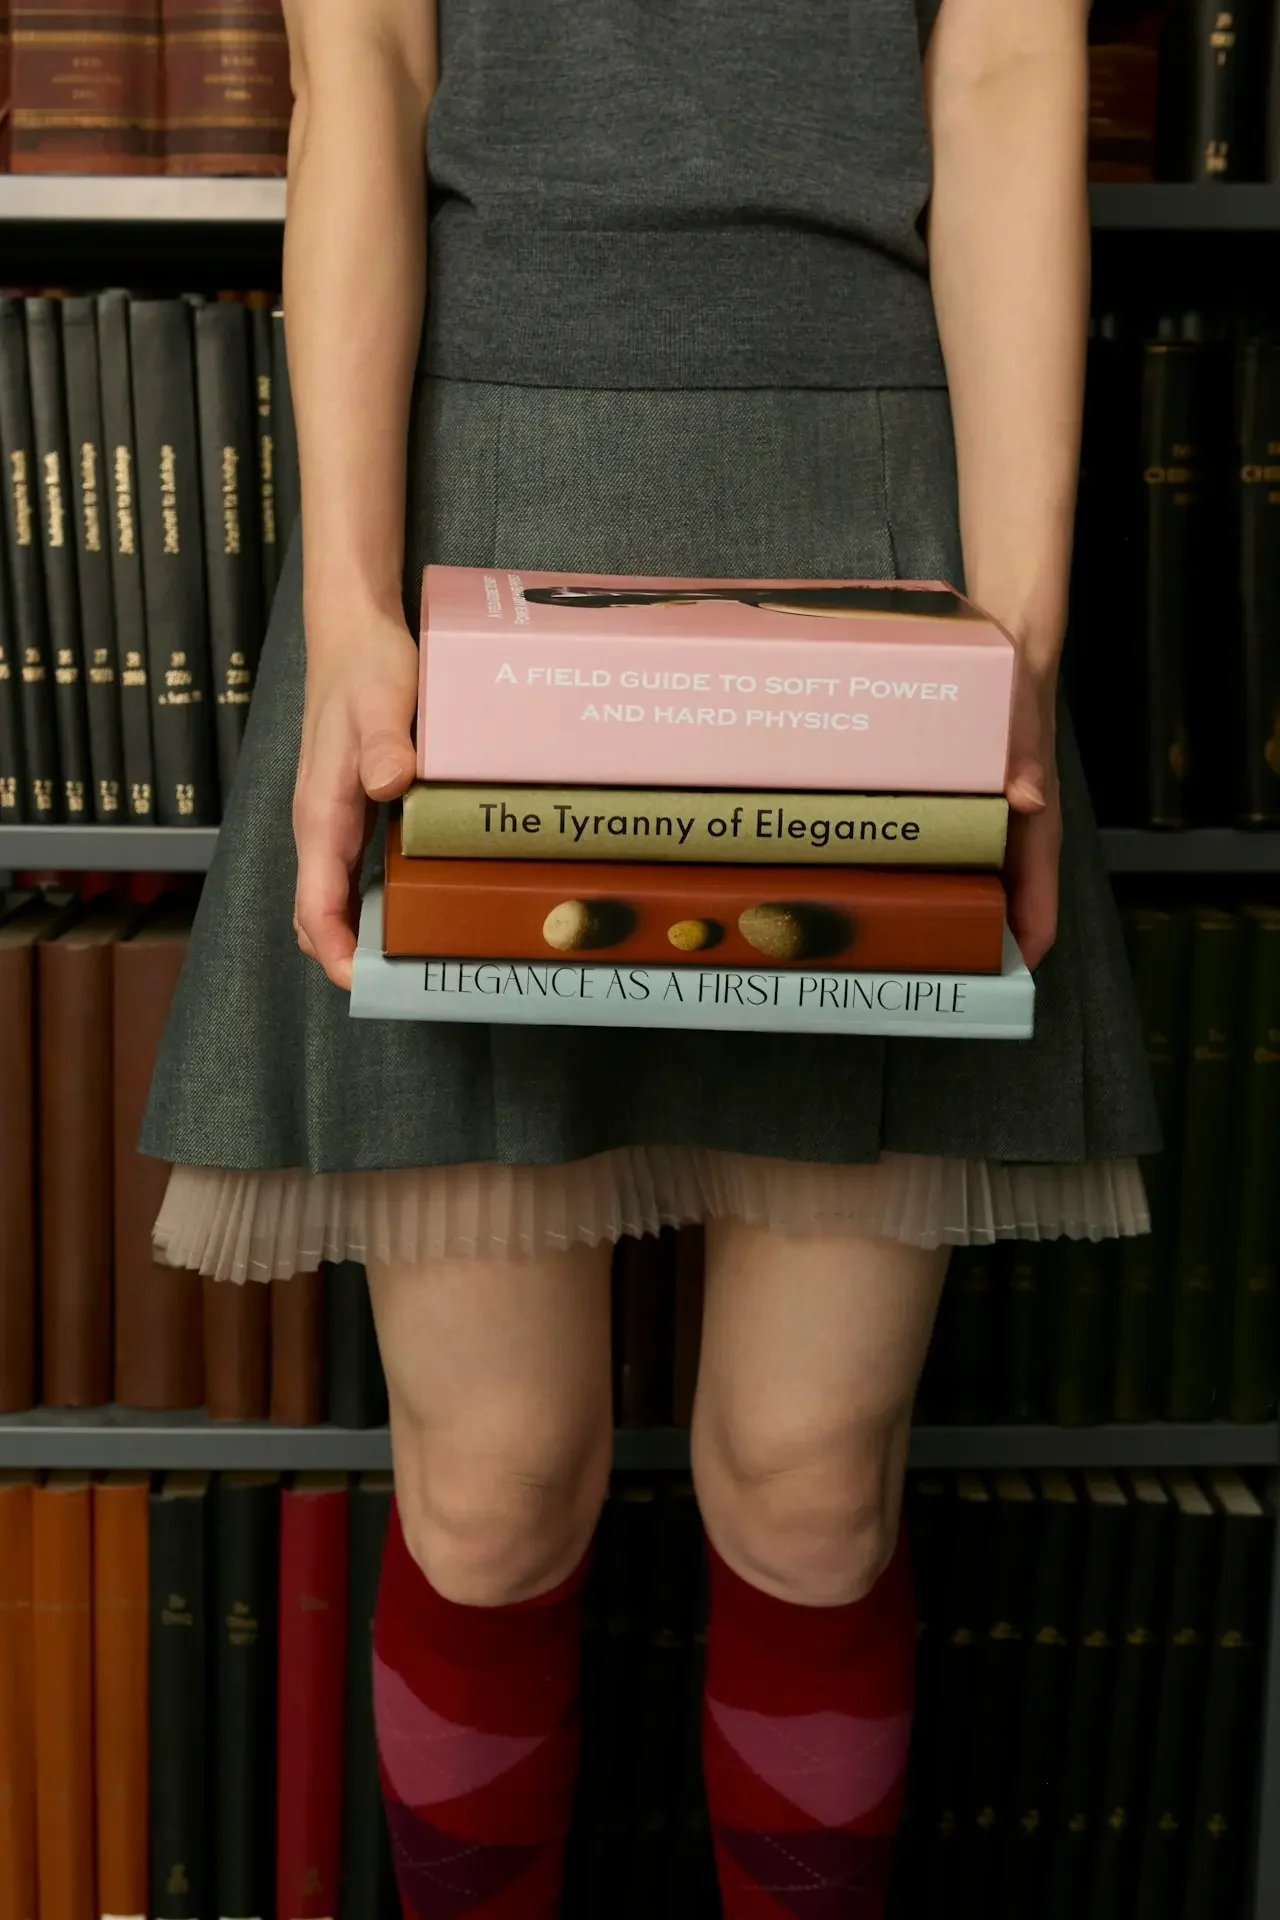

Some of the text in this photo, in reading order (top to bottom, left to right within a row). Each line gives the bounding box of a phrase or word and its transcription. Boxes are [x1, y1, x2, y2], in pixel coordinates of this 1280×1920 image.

[494, 663, 518, 684] A
[527, 667, 611, 687] FIELD
[620, 670, 711, 691] GUIDE
[718, 674, 757, 693] TO
[764, 676, 841, 697] SOFT
[581, 703, 869, 731] AND HARD PHYSICS
[479, 803, 920, 848] The Tyranny of Elegance
[423, 962, 966, 1013] ELEGANCE AS A FIRST PRINCIPLE
